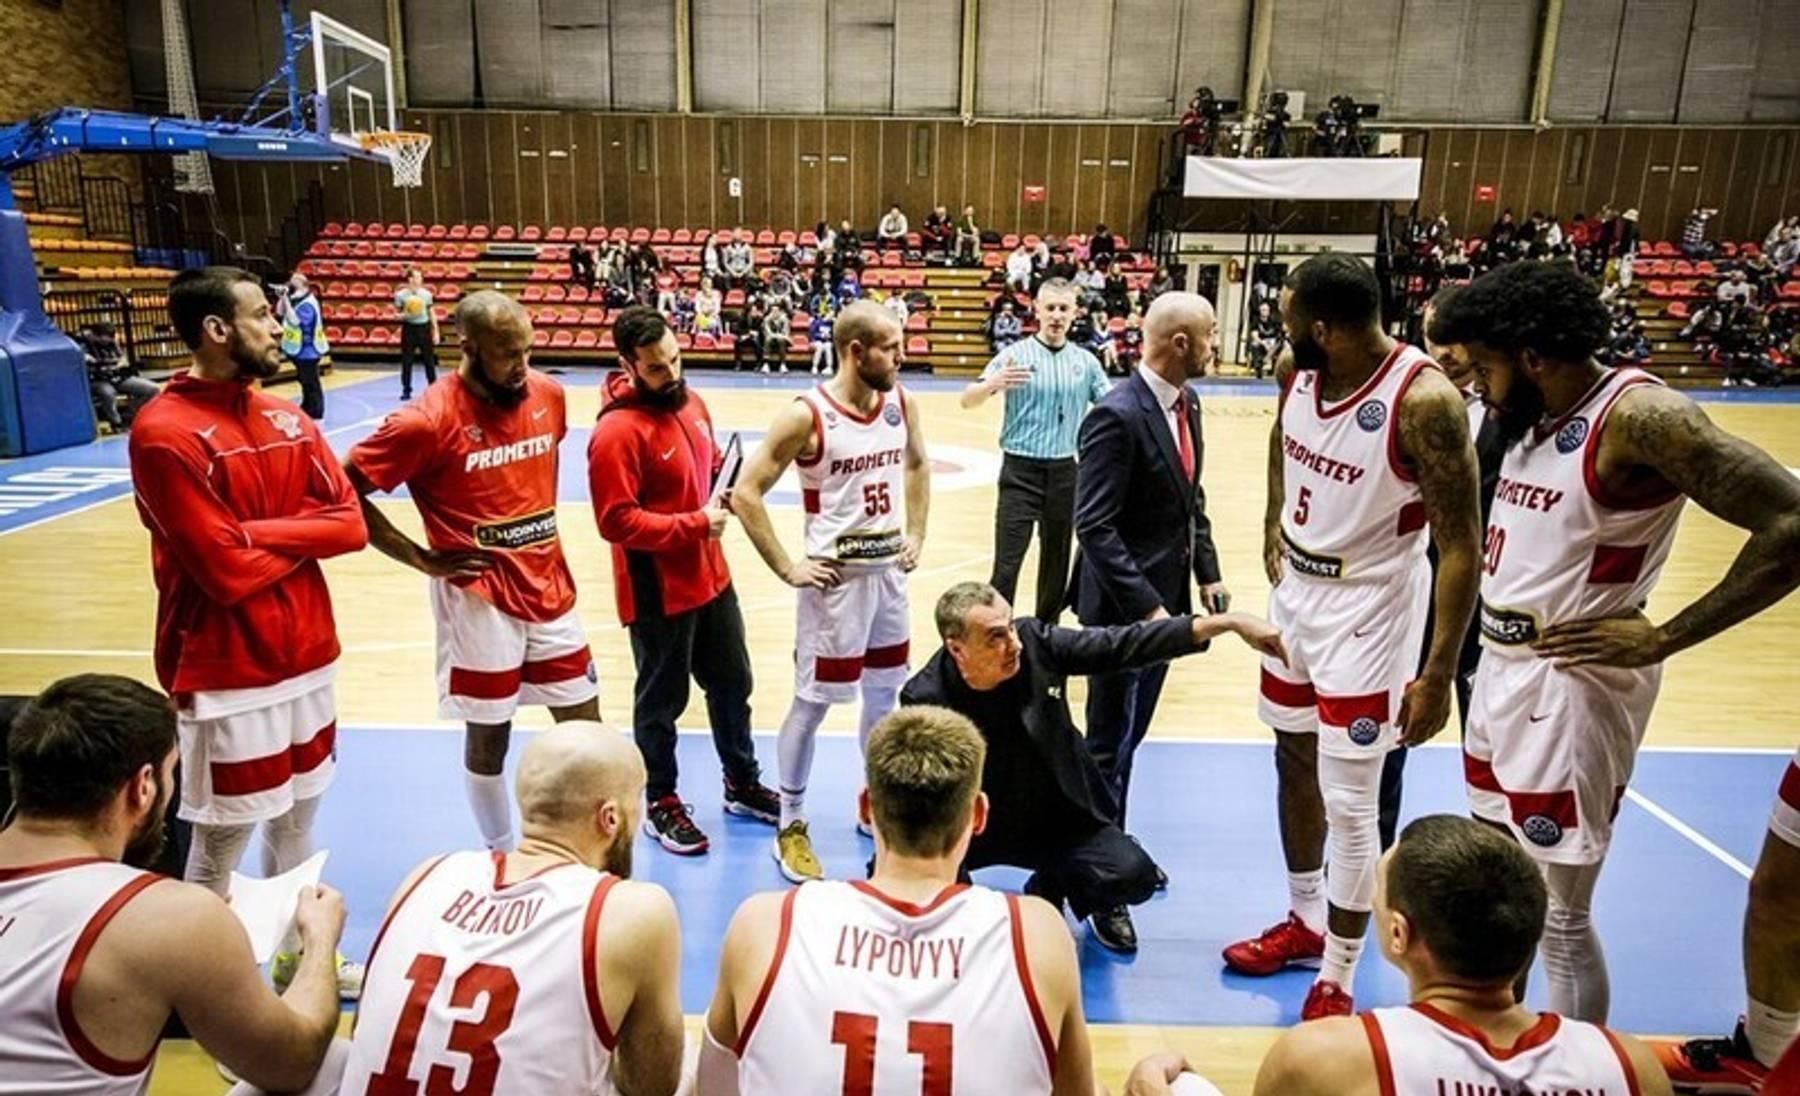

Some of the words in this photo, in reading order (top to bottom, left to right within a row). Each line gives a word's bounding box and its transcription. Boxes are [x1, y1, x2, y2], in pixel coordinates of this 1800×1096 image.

[465, 433, 553, 472] PROMETEY
[863, 481, 891, 517] 55
[1294, 486, 1312, 525] 5
[834, 925, 964, 979] LYPOVYY
[365, 953, 520, 1096] 13
[831, 1011, 953, 1096] 11
